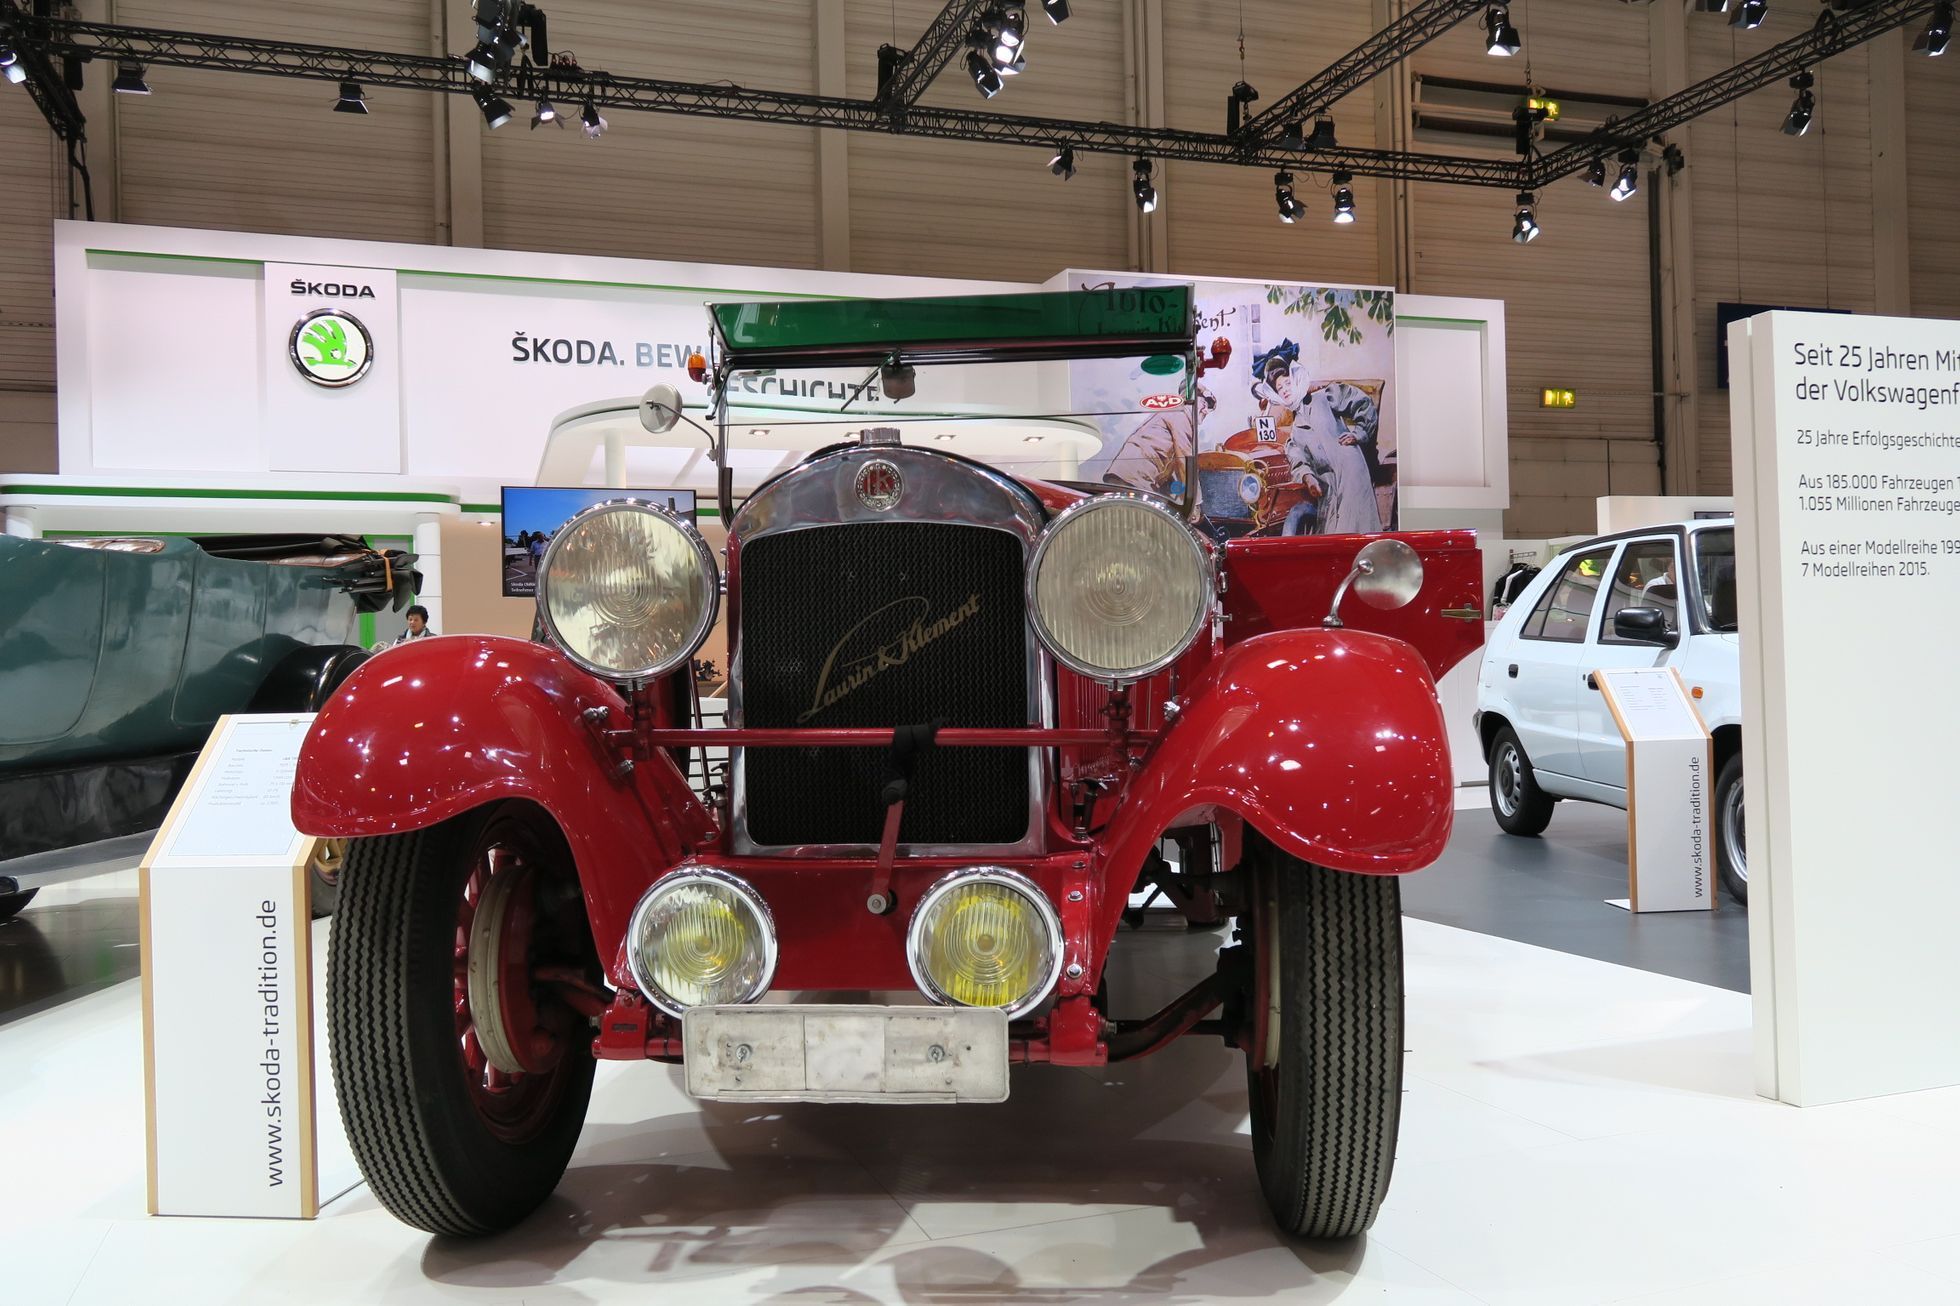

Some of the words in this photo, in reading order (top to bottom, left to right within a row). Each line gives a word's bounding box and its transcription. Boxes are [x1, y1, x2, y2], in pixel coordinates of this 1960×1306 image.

[291, 279, 375, 298] ŠKODA
[511, 331, 625, 366] ŠKODA.
[1794, 343, 1833, 366] Seit
[1840, 345, 1862, 367] 25
[1867, 346, 1929, 372] Jahren
[1796, 376, 1828, 400] der
[1259, 419, 1269, 428] N
[1259, 430, 1275, 440] 130
[1797, 430, 1812, 444] 25
[1816, 430, 1849, 447] Jahre
[1852, 430, 1960, 450] Erfolgsgeschichte
[1799, 474, 1823, 489] Aus
[1826, 474, 1878, 489] 185.000
[1882, 475, 1953, 493] Fahrzeugen
[1799, 496, 1832, 511] 1.055
[1836, 496, 1893, 511] Millionen
[1801, 540, 1825, 555] Aus
[1829, 540, 1861, 555] einer
[1865, 539, 1937, 555] Modellreihe
[1802, 563, 1809, 577] 7
[1813, 562, 1895, 577] Modellreihen
[1899, 561, 1930, 576] 2015.
[1689, 757, 1703, 898] www.skoda-tradition.de
[256, 900, 283, 1188] www.skoda-tradition.de
